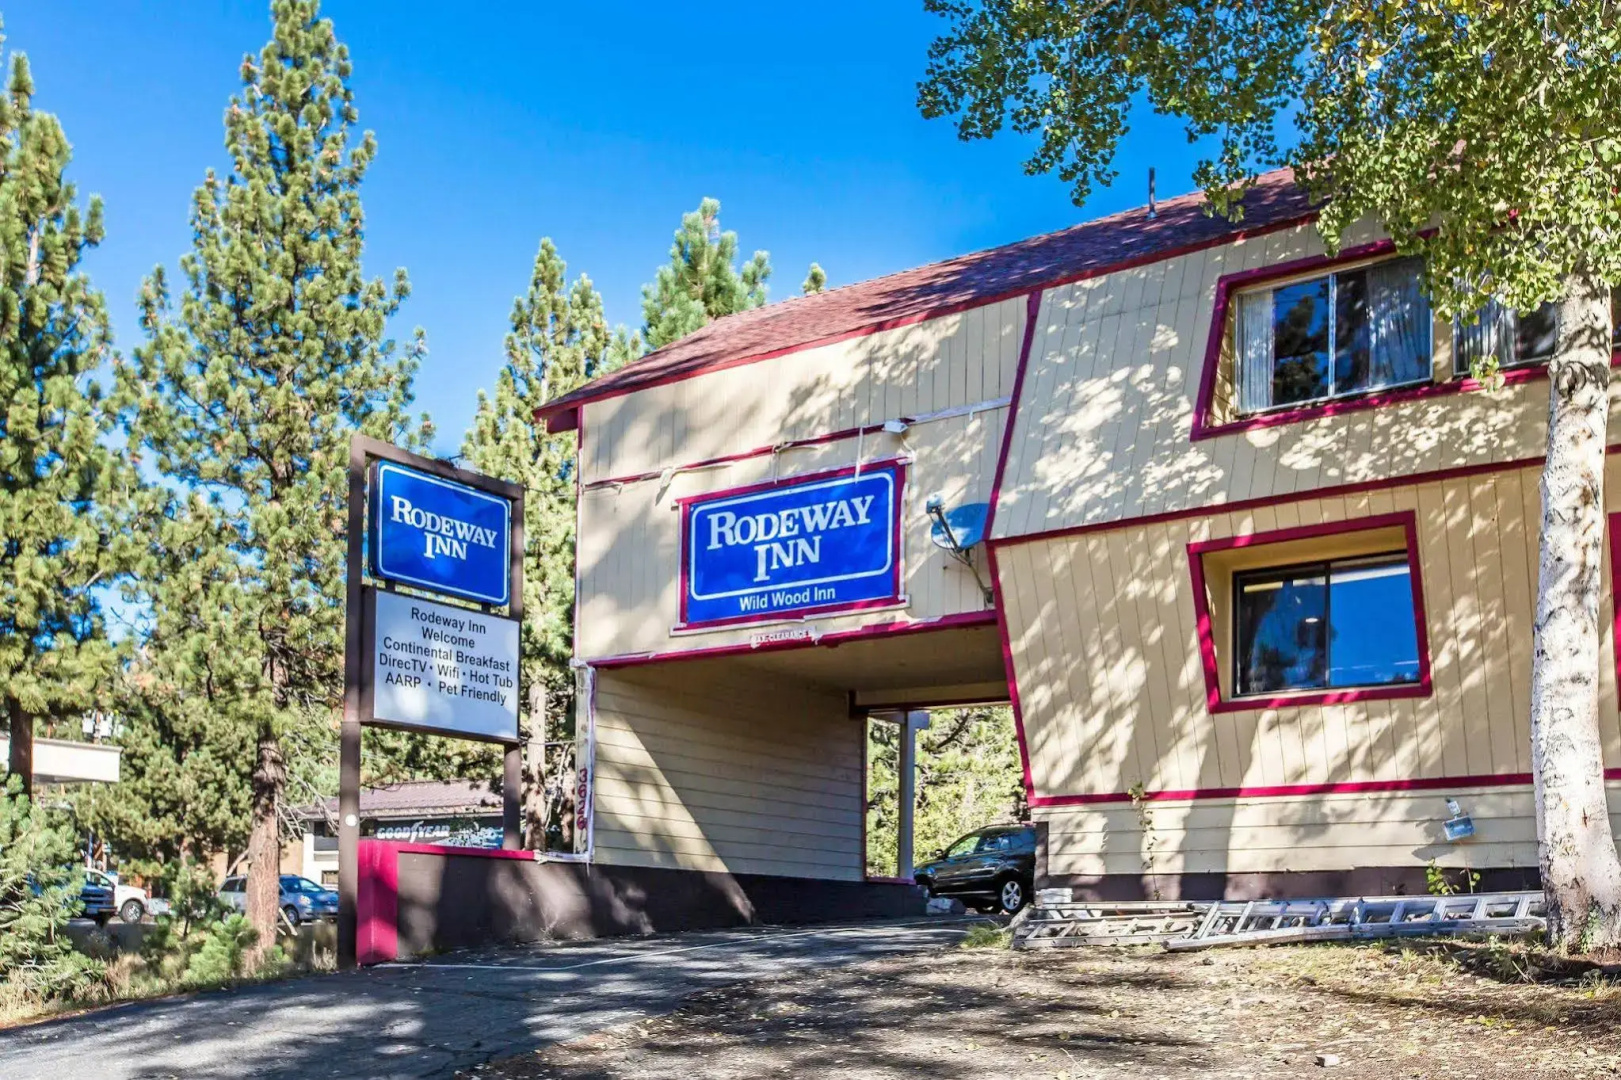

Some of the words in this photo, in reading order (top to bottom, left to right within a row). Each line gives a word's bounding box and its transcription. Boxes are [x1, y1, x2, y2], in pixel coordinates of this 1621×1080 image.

[390, 494, 498, 549] RODEWAY
[706, 494, 875, 551] RODEWAY
[423, 531, 468, 560] INN
[753, 535, 822, 583] INN
[739, 593, 768, 611] Wild
[771, 588, 810, 607] Wood
[814, 586, 836, 601] Inn
[411, 606, 465, 632] Rodeway
[468, 619, 486, 634] Inn
[421, 626, 475, 649] Welcome
[383, 636, 453, 661] Continental
[456, 650, 510, 672] Breakfast
[385, 672, 421, 688] AARP
[438, 680, 458, 696] Pet
[461, 685, 507, 706] Friendly
[437, 663, 460, 679] Wifi
[469, 669, 490, 685] Hot
[493, 673, 513, 688] Tub
